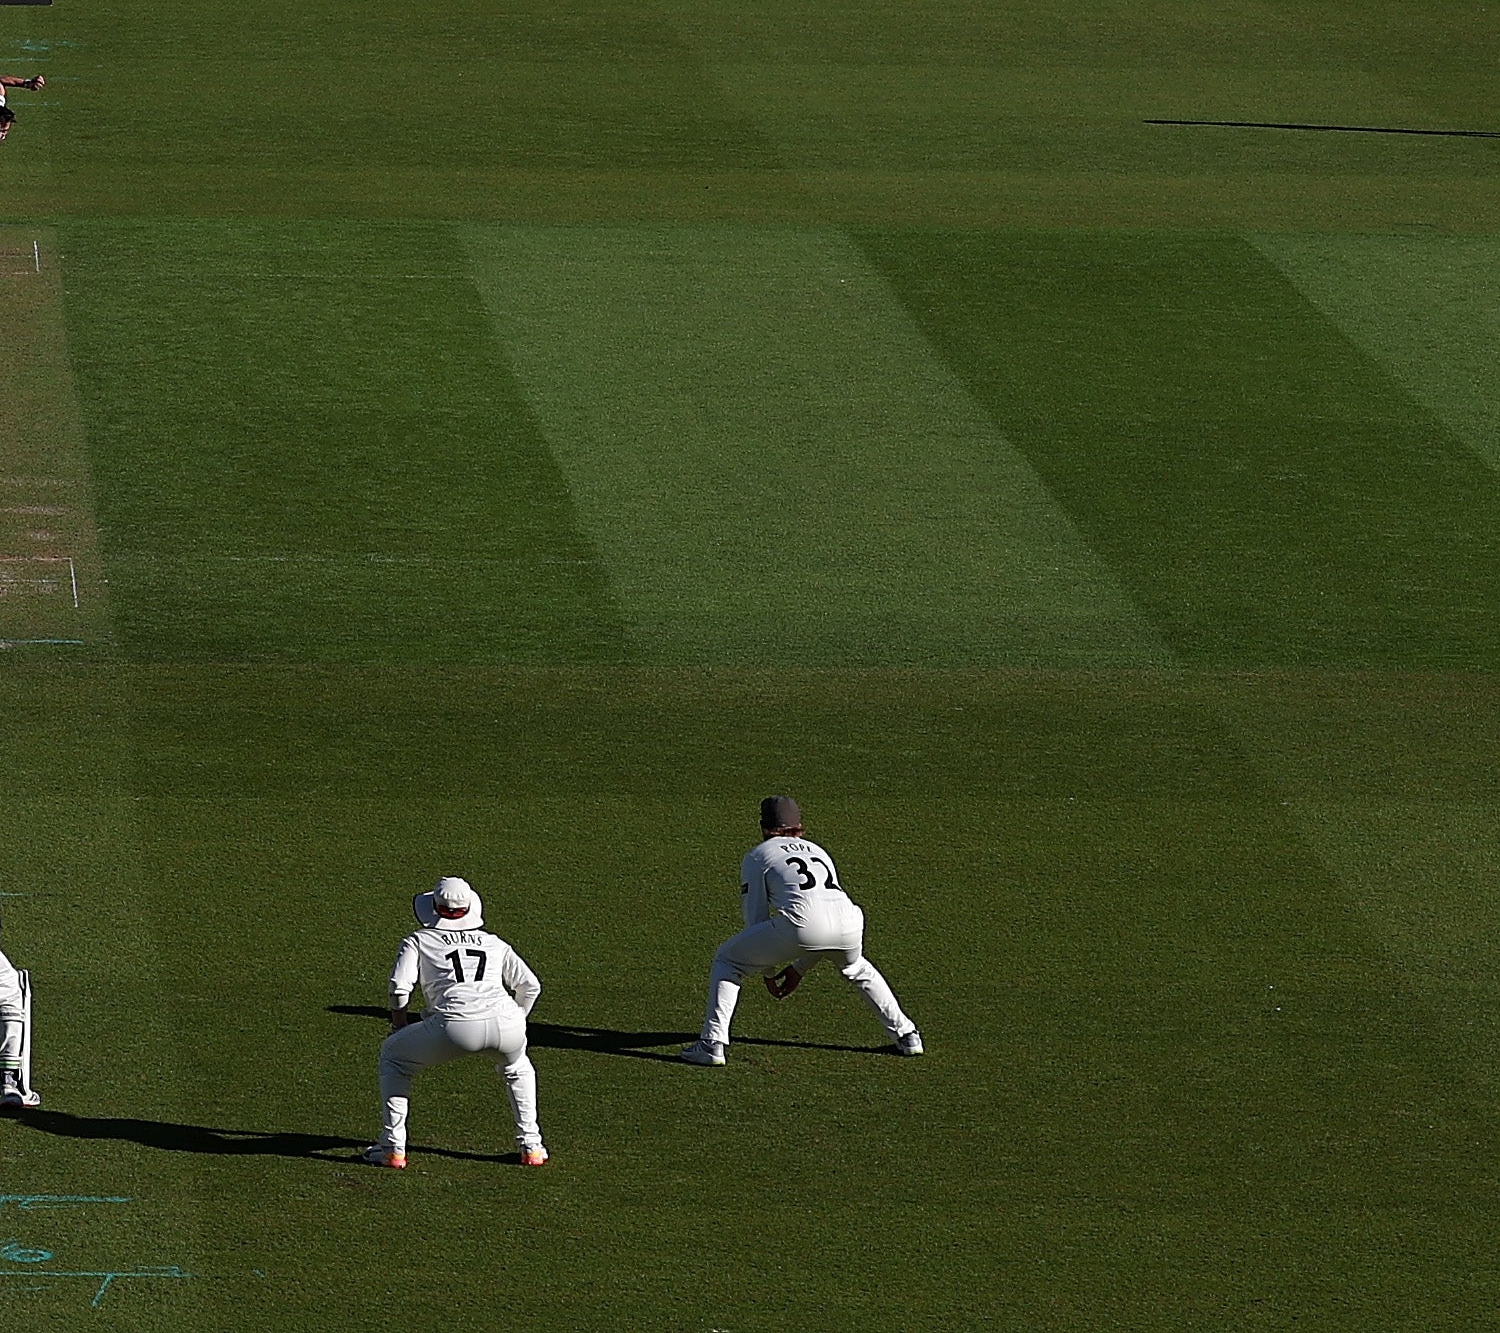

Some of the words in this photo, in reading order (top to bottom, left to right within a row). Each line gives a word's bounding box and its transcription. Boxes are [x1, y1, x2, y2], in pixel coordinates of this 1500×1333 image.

[785, 856, 843, 891] 32
[441, 932, 483, 947] BURNS
[445, 948, 488, 983] 17
